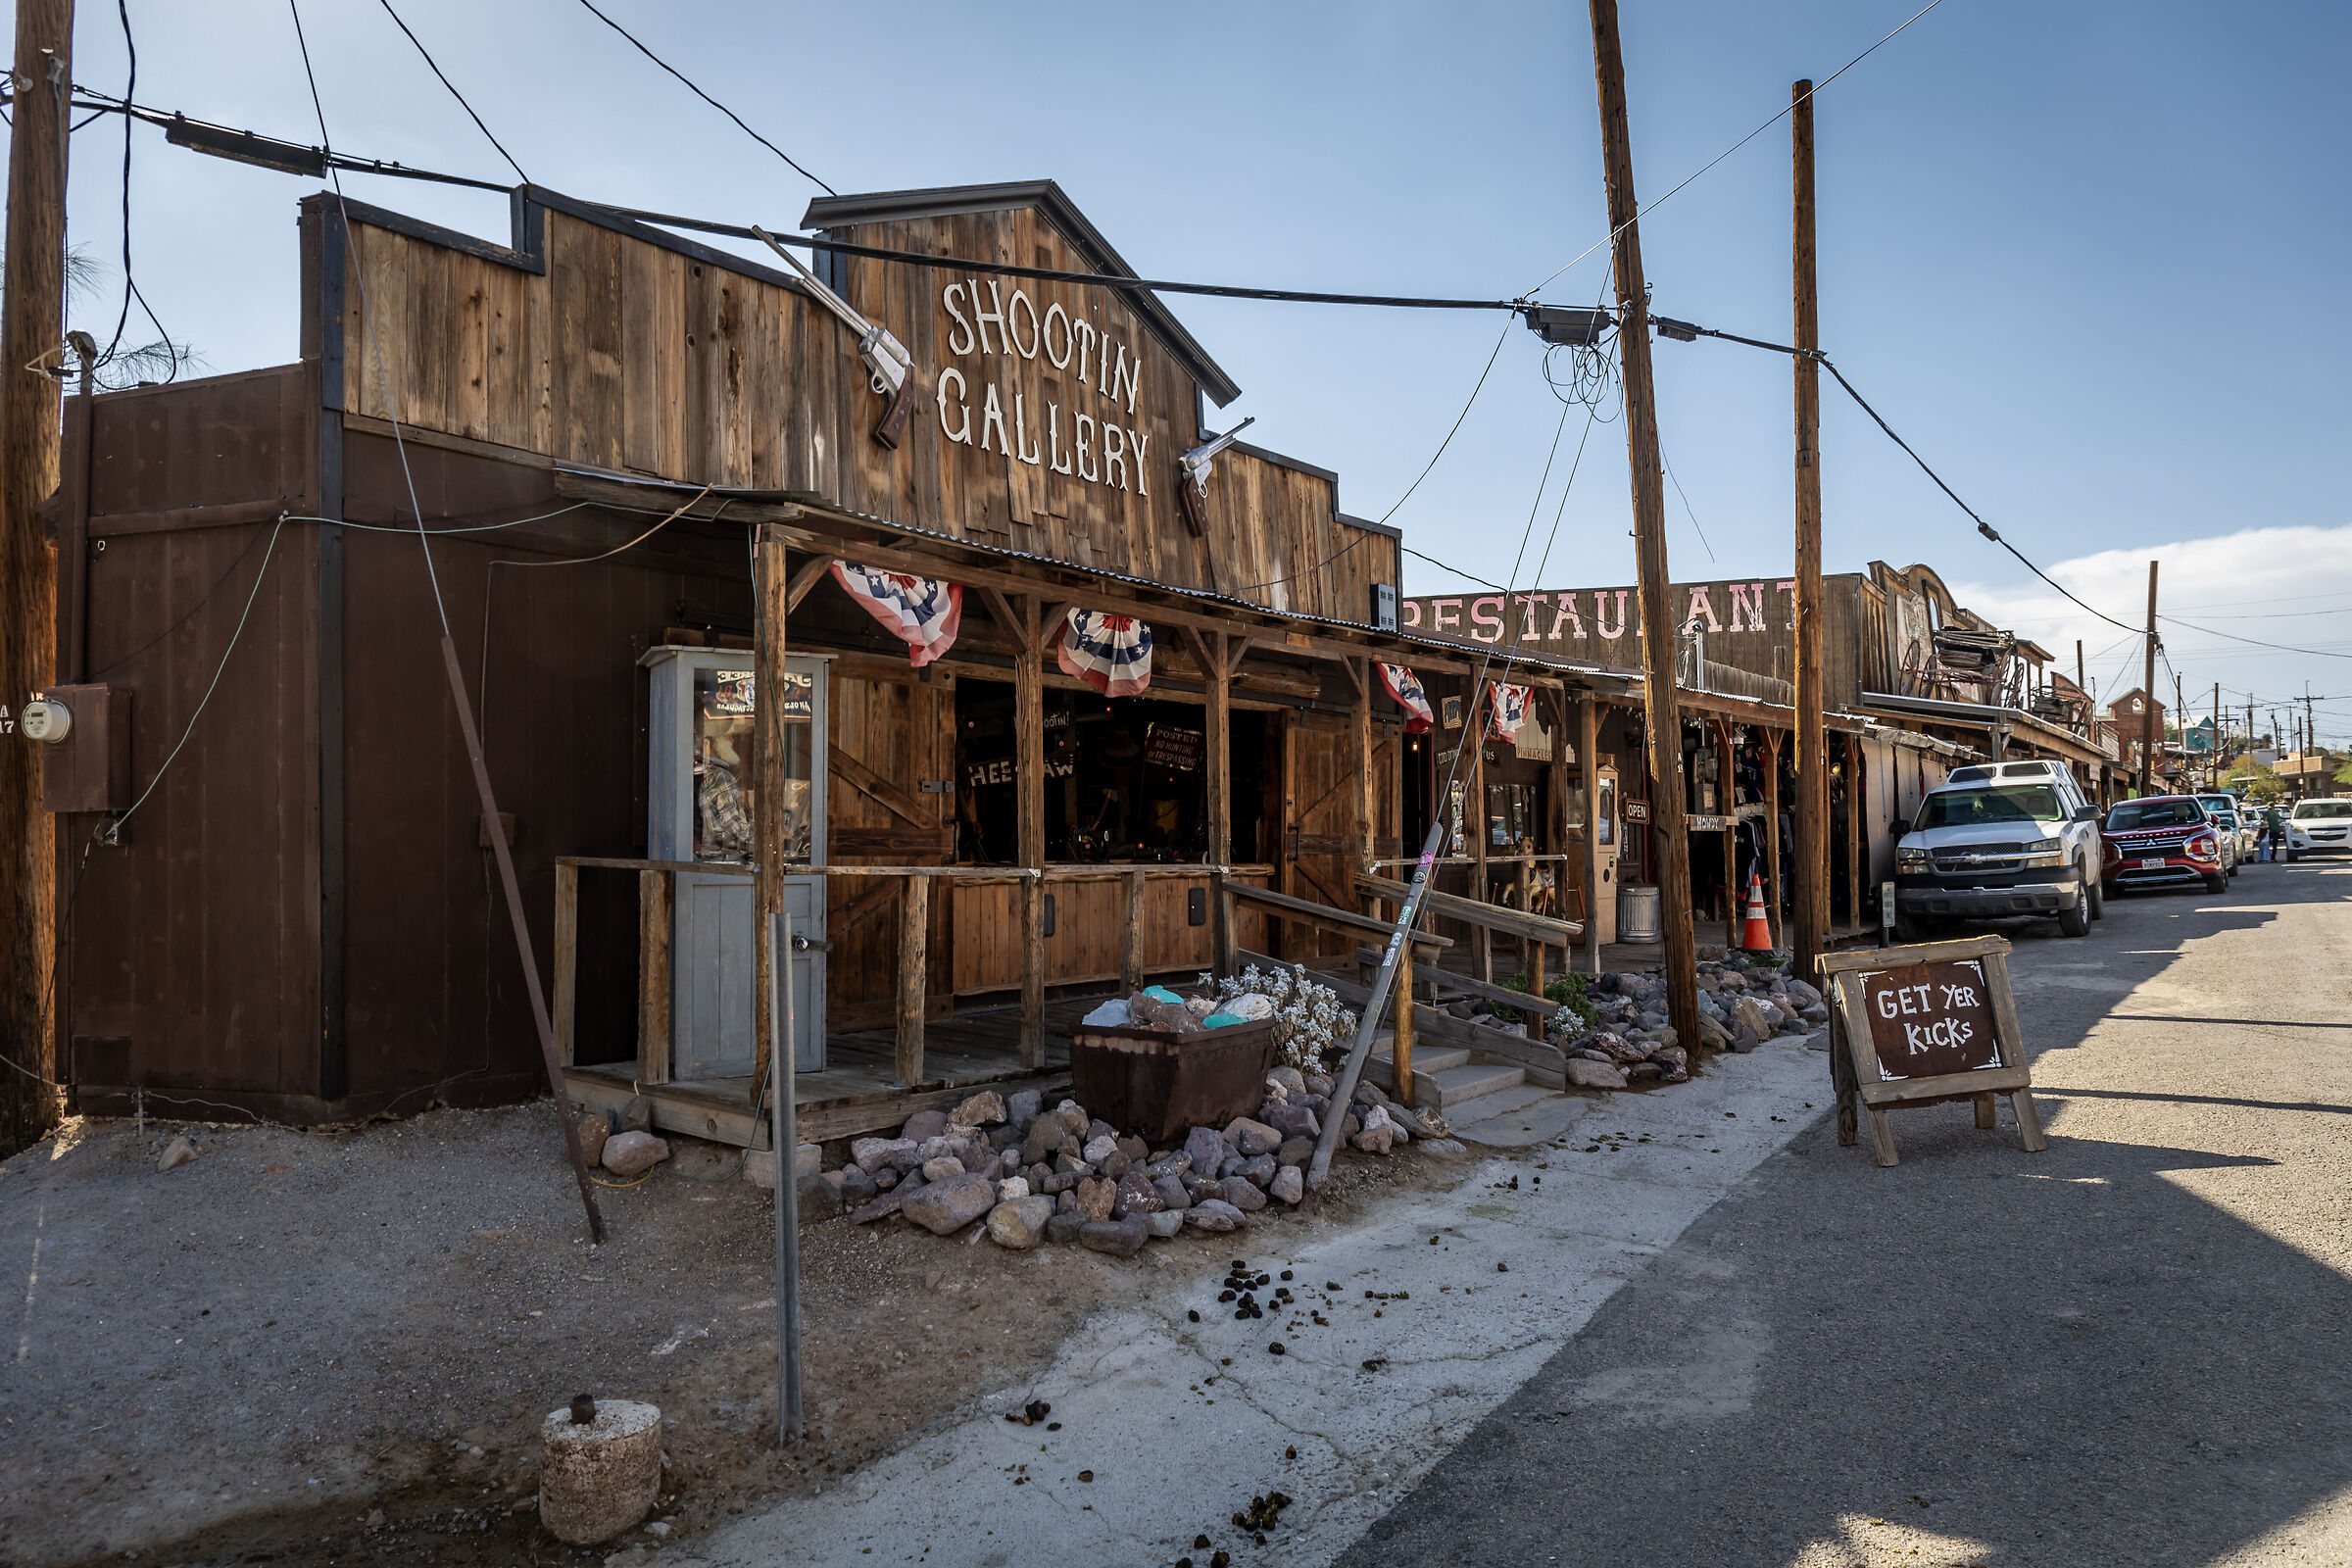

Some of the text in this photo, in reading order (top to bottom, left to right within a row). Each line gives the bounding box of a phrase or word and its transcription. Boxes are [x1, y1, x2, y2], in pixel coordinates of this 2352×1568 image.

[943, 278, 1142, 416] SHOOTIN
[936, 367, 1149, 497] GALLERY
[1402, 581, 1796, 643] ESTAUANT
[1043, 710, 1070, 728] OOTIN!
[1156, 729, 1198, 743] POSTED
[1516, 748, 1551, 760] PINNACLES
[1628, 804, 1646, 818] OPEN
[1696, 816, 1719, 830] HOWDY
[1877, 983, 1981, 1019] GET YER
[1904, 1017, 1974, 1055] KICKS
